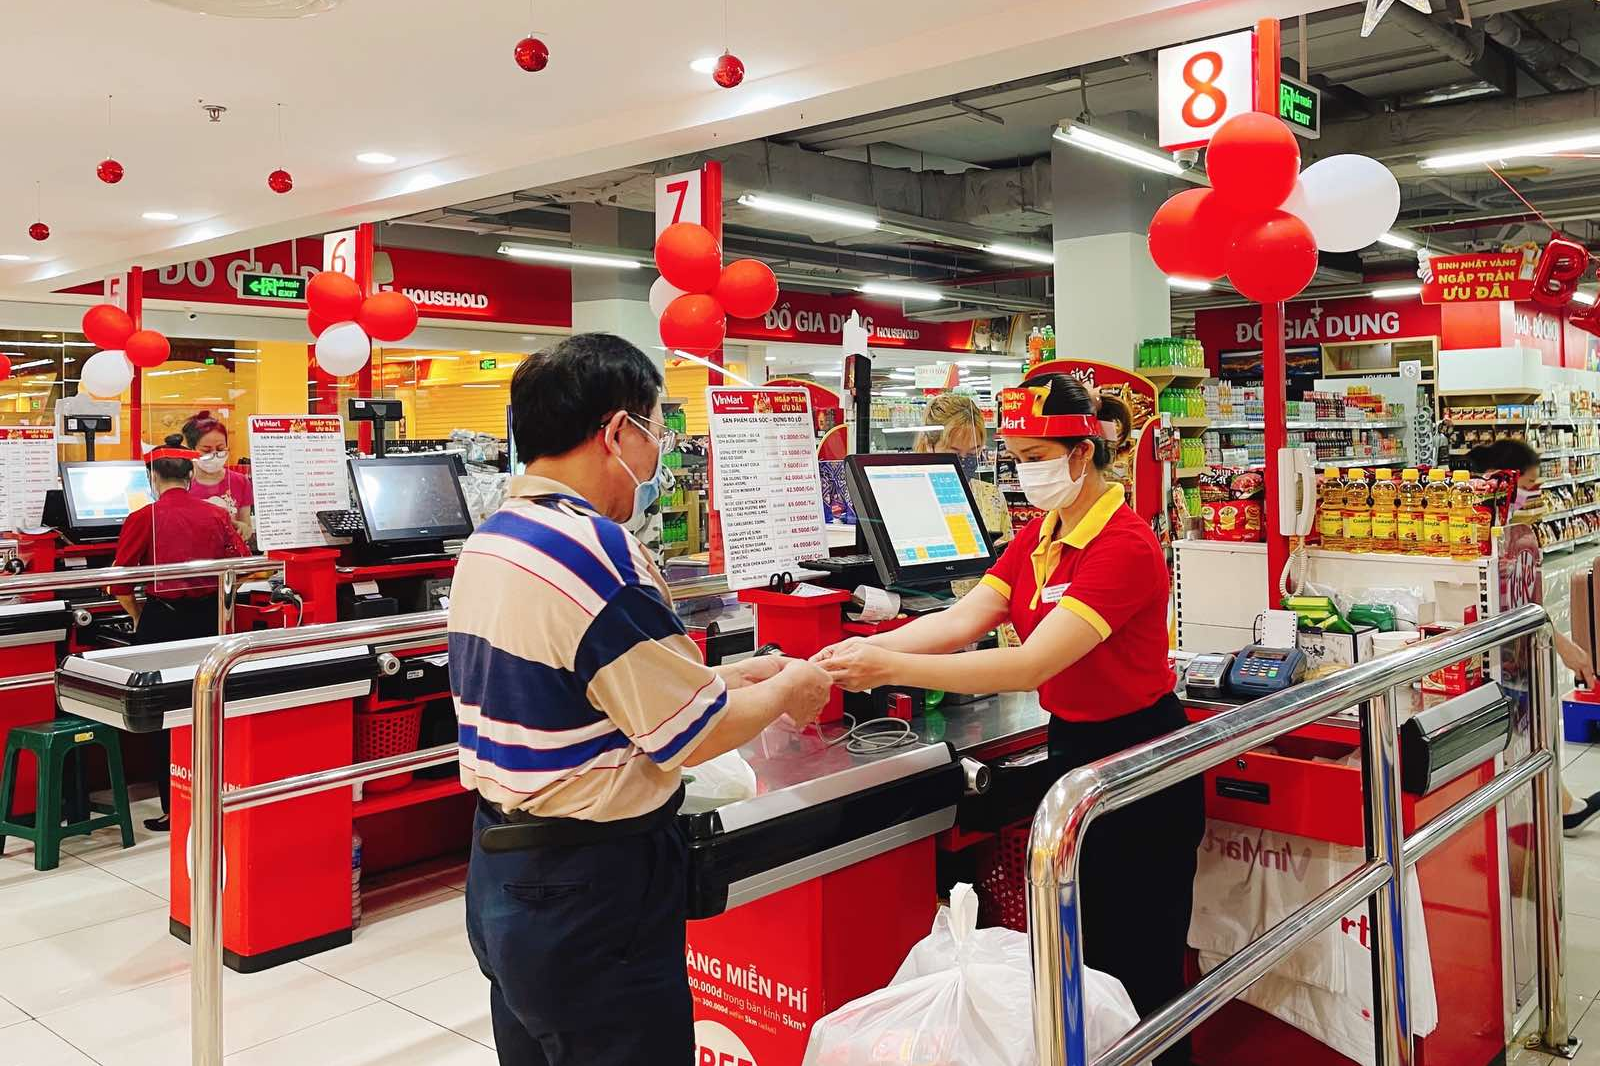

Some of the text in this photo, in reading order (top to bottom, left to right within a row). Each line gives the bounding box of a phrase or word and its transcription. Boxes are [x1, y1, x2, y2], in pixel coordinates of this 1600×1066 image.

[1181, 51, 1227, 128] 8
[666, 180, 689, 225] 7
[331, 237, 346, 273] 6
[1438, 270, 1515, 285] NGẬP TRÀN
[1442, 283, 1510, 300] ƯU ĐÃI
[401, 288, 488, 309] HOUSEHOLD
[765, 303, 874, 337] ĐỒ GIA DG
[876, 326, 920, 340] HOUSEHOLD
[1326, 311, 1400, 341] DỤNG
[713, 393, 744, 407] VinMart
[170, 763, 187, 780] GIAO
[686, 943, 808, 1014] ÀNG MIỄN PHÍ
[723, 991, 744, 1010] trong
[746, 999, 761, 1014] bán
[763, 1004, 780, 1022] kính
